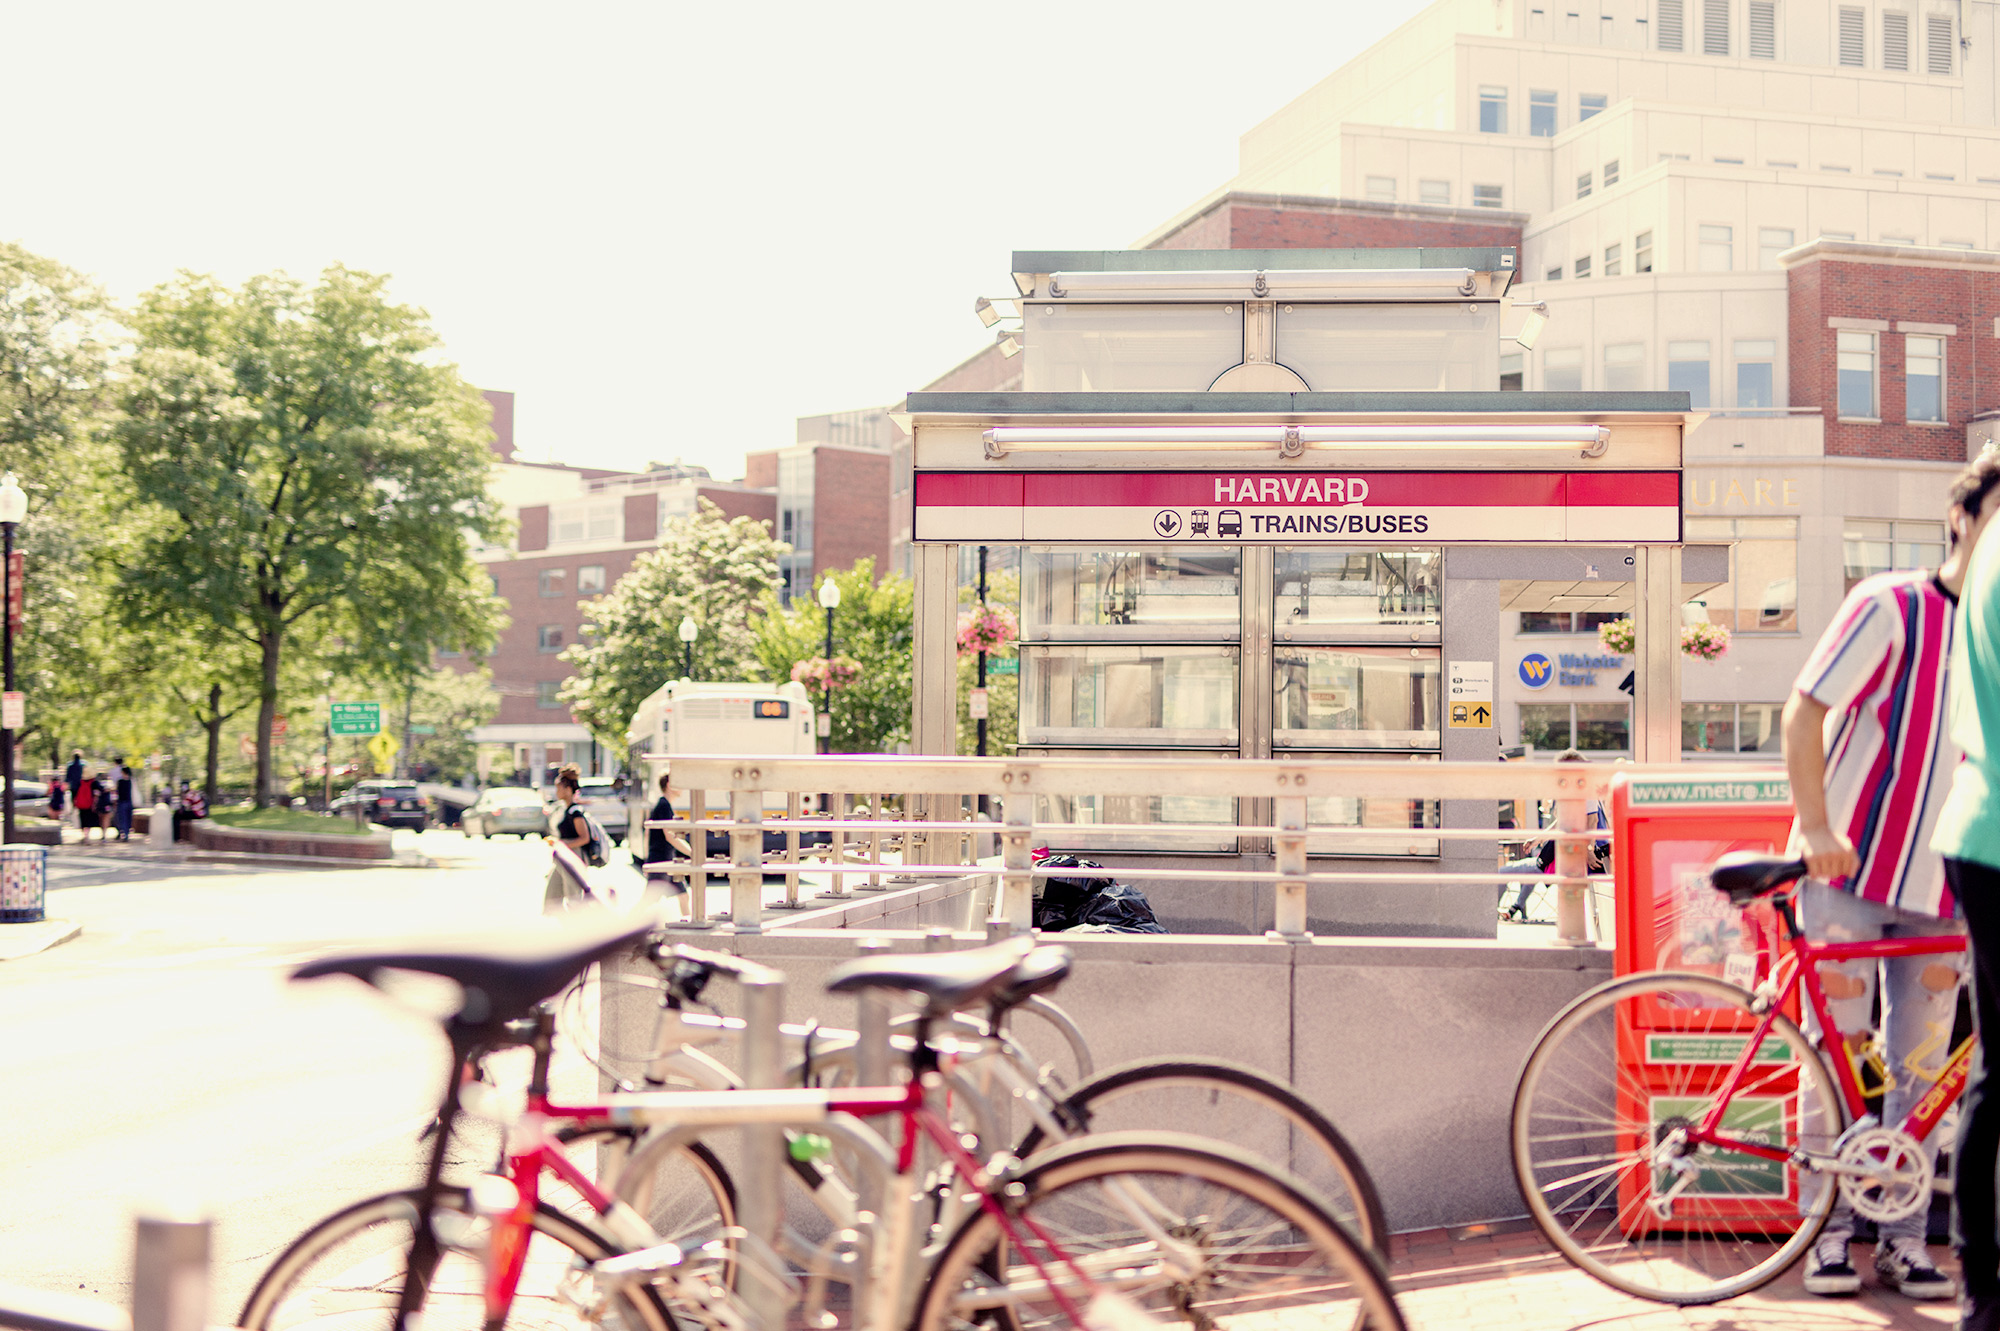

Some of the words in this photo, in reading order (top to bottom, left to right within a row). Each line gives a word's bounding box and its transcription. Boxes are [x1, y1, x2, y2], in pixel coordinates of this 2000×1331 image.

[1214, 478, 1369, 502] HARVARD
[1685, 478, 1800, 514] UARE
[1250, 515, 1429, 533] TRAINS/BUSES
[1558, 654, 1624, 669] Webster
[1558, 671, 1597, 686] Bank
